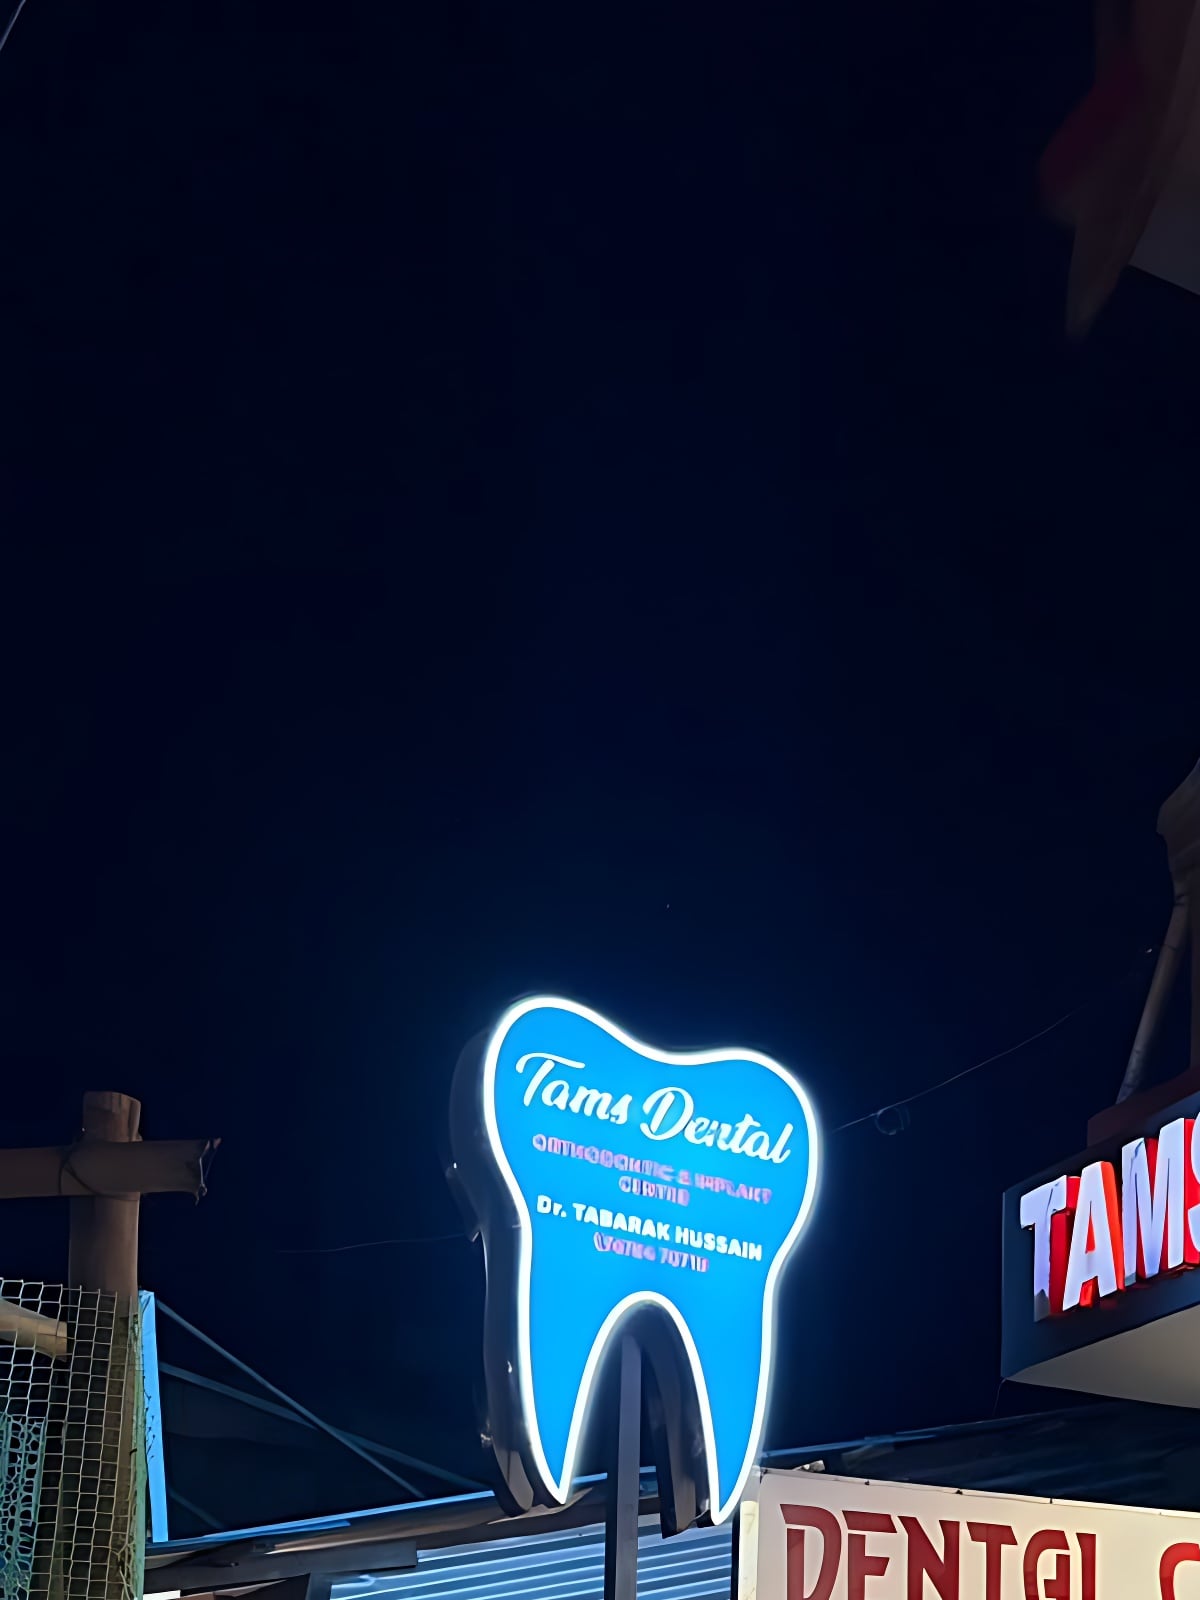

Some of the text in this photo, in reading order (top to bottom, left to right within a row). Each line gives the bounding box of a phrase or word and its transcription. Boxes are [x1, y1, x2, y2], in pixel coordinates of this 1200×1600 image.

[515, 1051, 794, 1164] Tams Dental
[536, 1195, 567, 1218] Dr.
[572, 1202, 672, 1242] TABARAK
[675, 1226, 764, 1261] HUSSAIN
